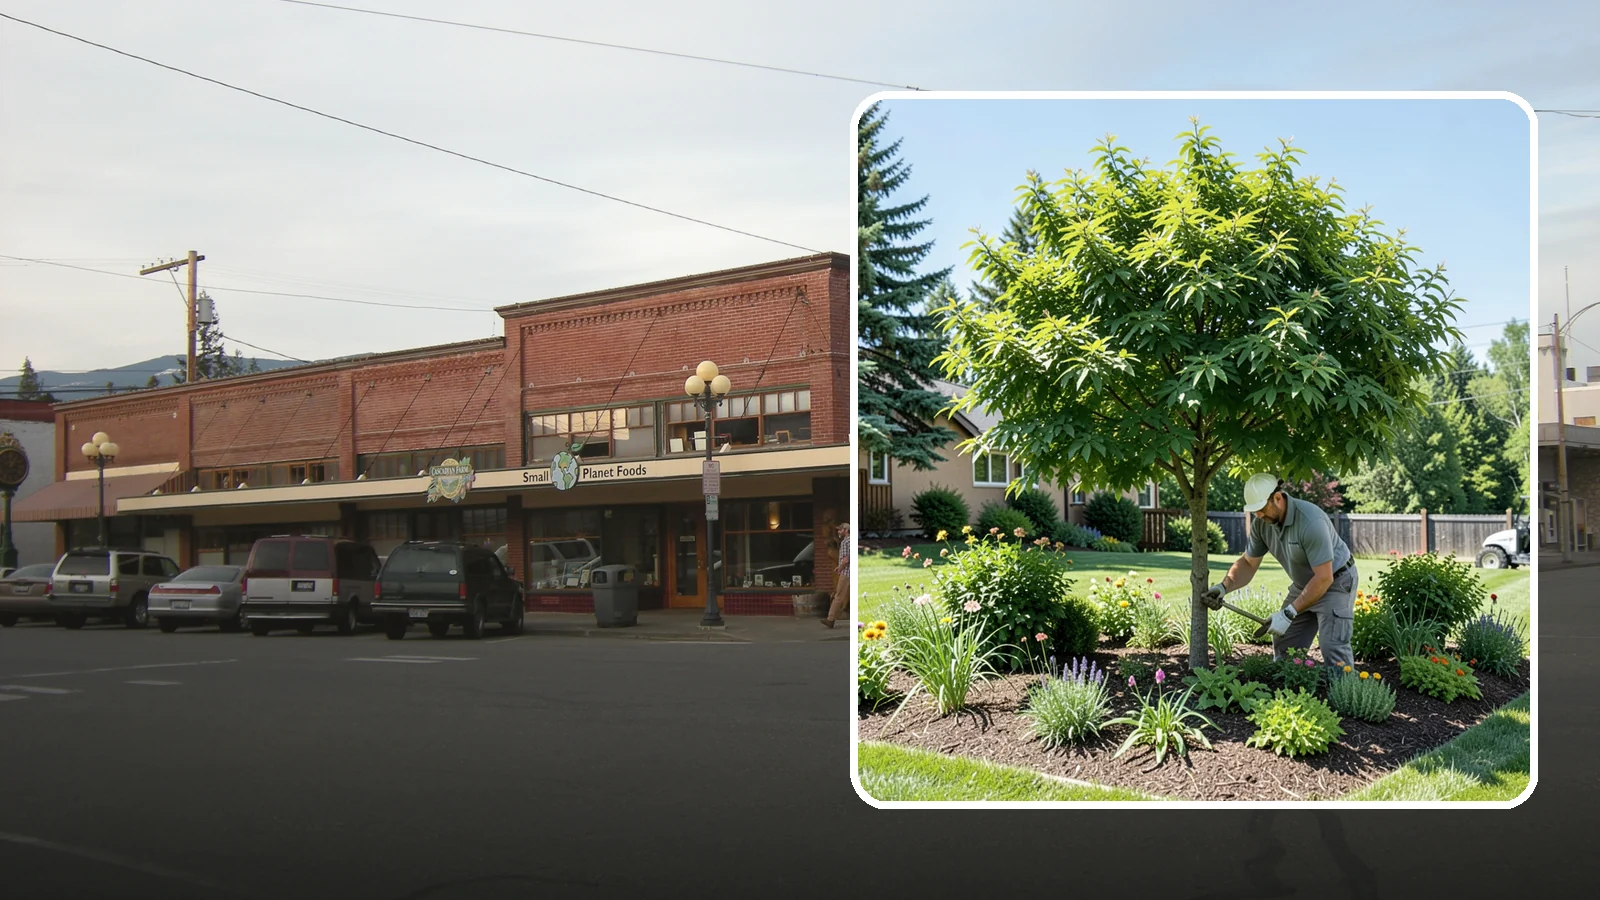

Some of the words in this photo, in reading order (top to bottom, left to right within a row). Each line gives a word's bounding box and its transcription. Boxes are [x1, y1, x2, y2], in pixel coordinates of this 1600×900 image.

[523, 471, 549, 483] Small
[583, 467, 613, 479] Planet
[617, 464, 646, 477] Foods
